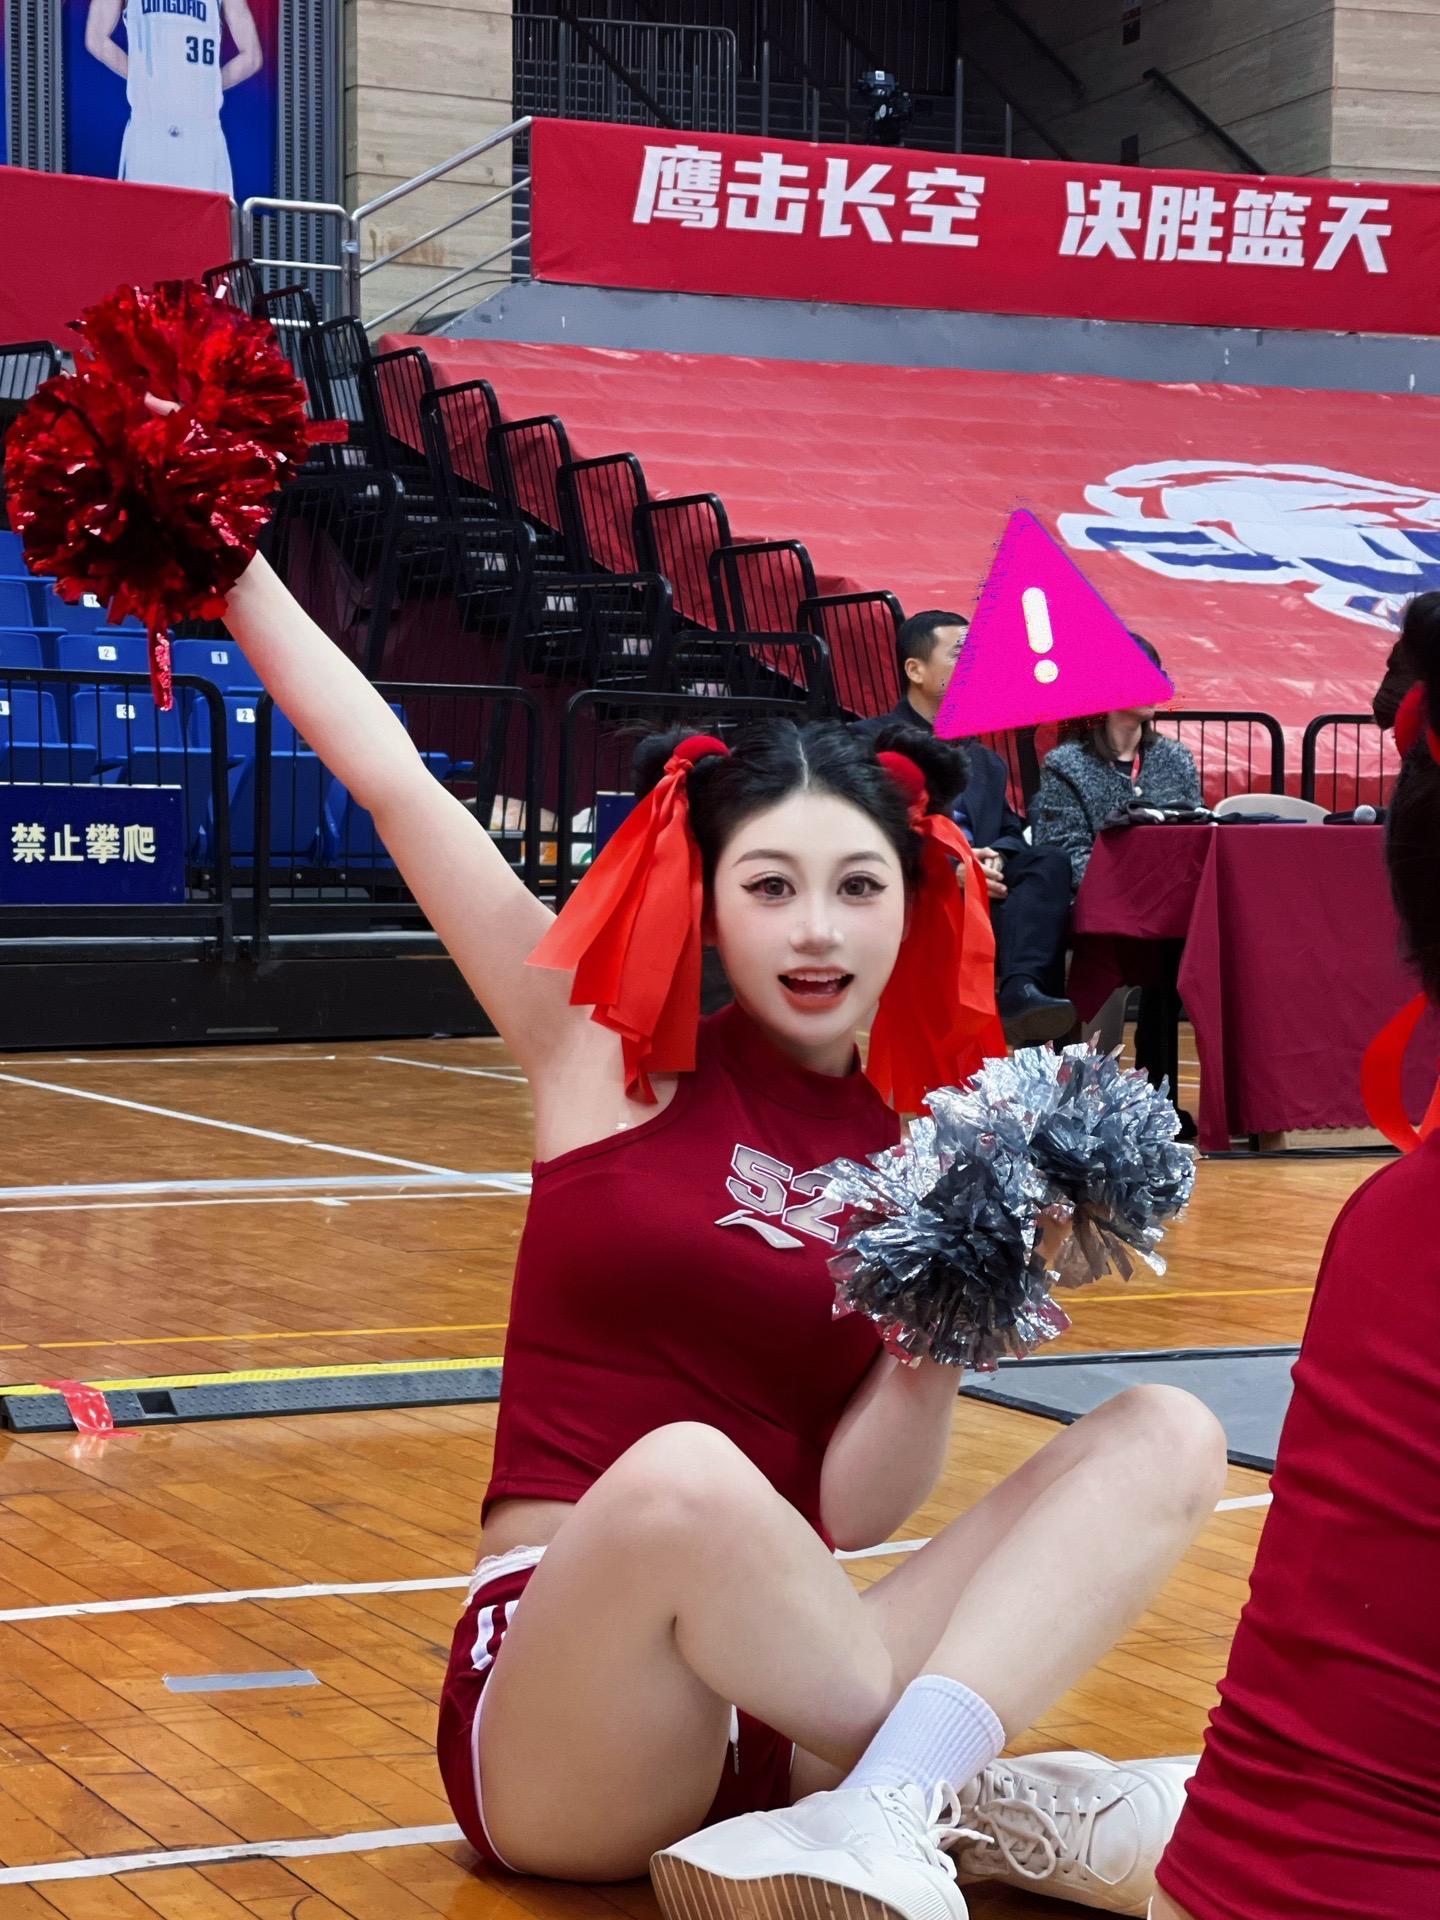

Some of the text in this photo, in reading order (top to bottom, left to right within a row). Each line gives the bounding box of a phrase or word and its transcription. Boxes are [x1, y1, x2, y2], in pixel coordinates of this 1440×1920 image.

[186, 36, 215, 65] 36
[632, 144, 1392, 273] 鹰击长空 决胜篮天
[11, 822, 157, 864] 禁止攀爬
